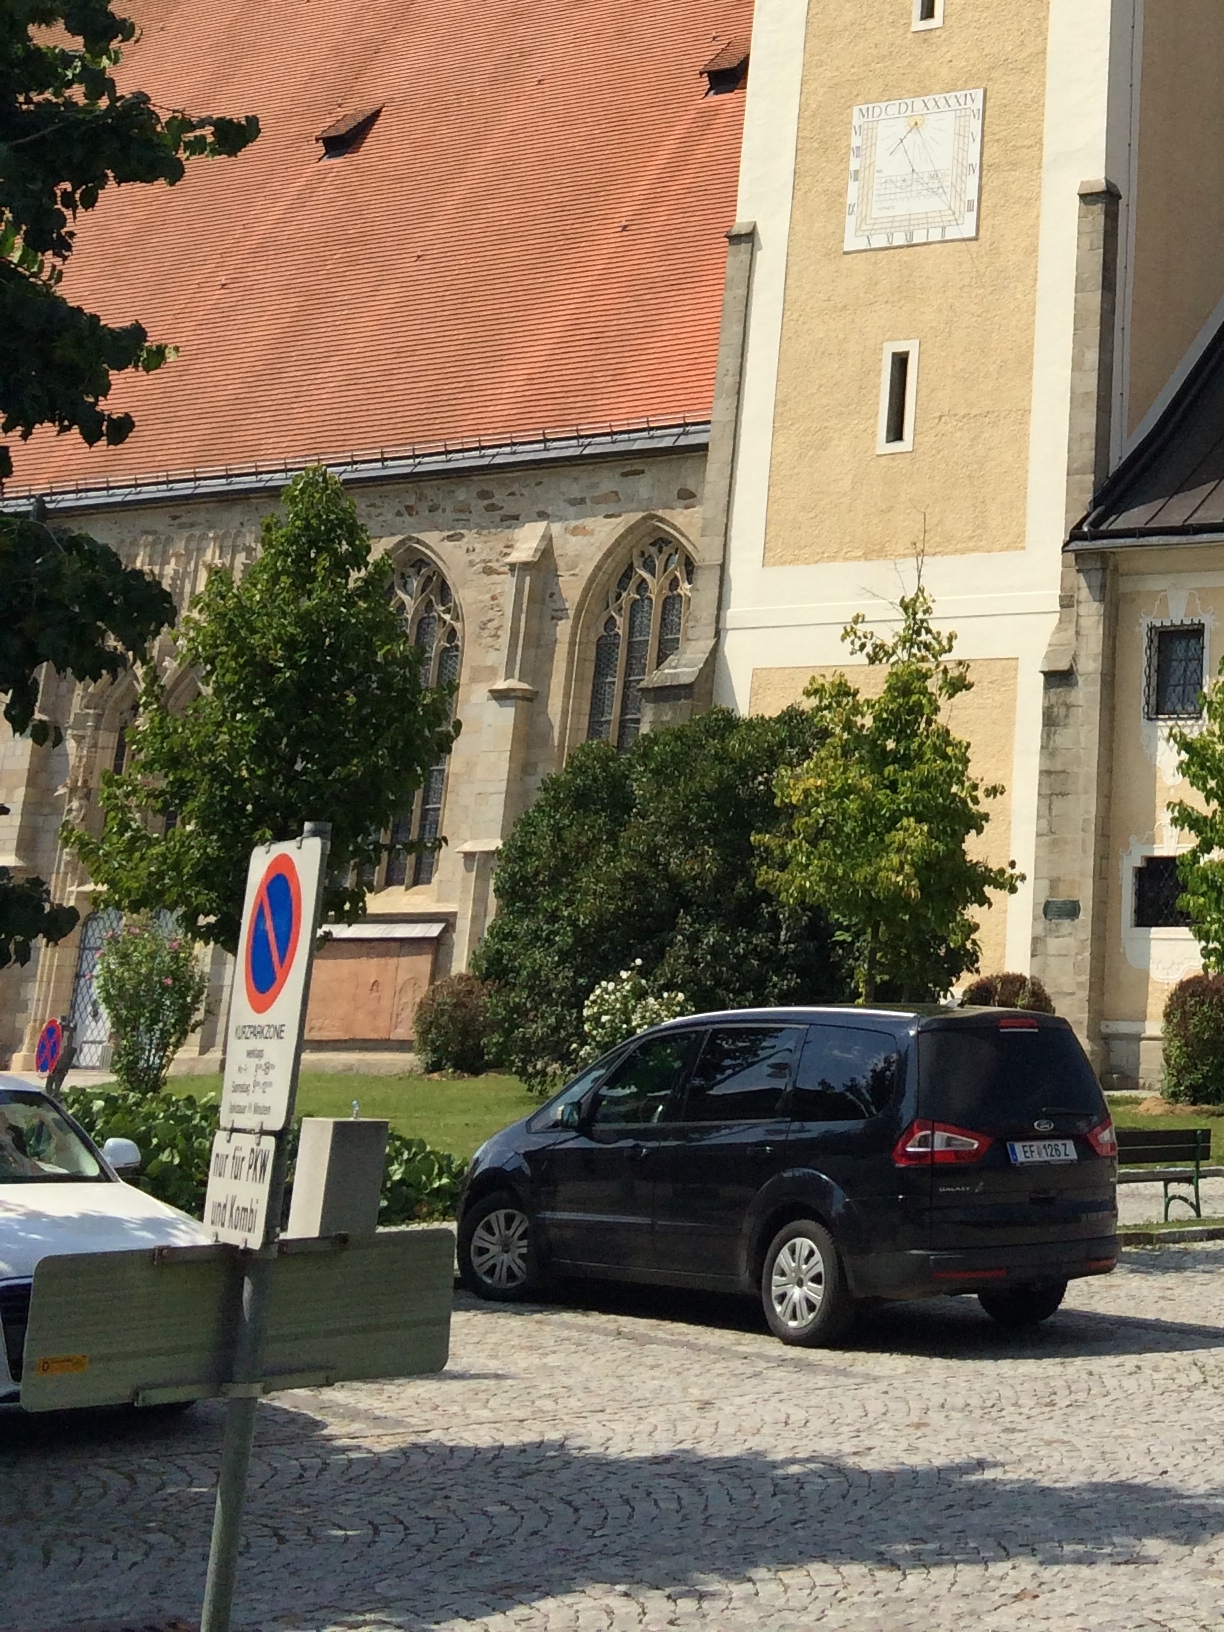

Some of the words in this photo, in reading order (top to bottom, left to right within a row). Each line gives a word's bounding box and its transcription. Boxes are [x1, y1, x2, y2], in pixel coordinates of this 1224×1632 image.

[235, 1024, 286, 1040] KURZPARKZONE
[213, 1153, 230, 1179] nur
[230, 1145, 246, 1181] für
[245, 1147, 270, 1184] PKW
[1022, 1144, 1036, 1159] EF
[1042, 1143, 1061, 1158] 126
[1061, 1143, 1070, 1157] Z
[211, 1194, 228, 1229] und
[228, 1194, 259, 1234] Kombi
